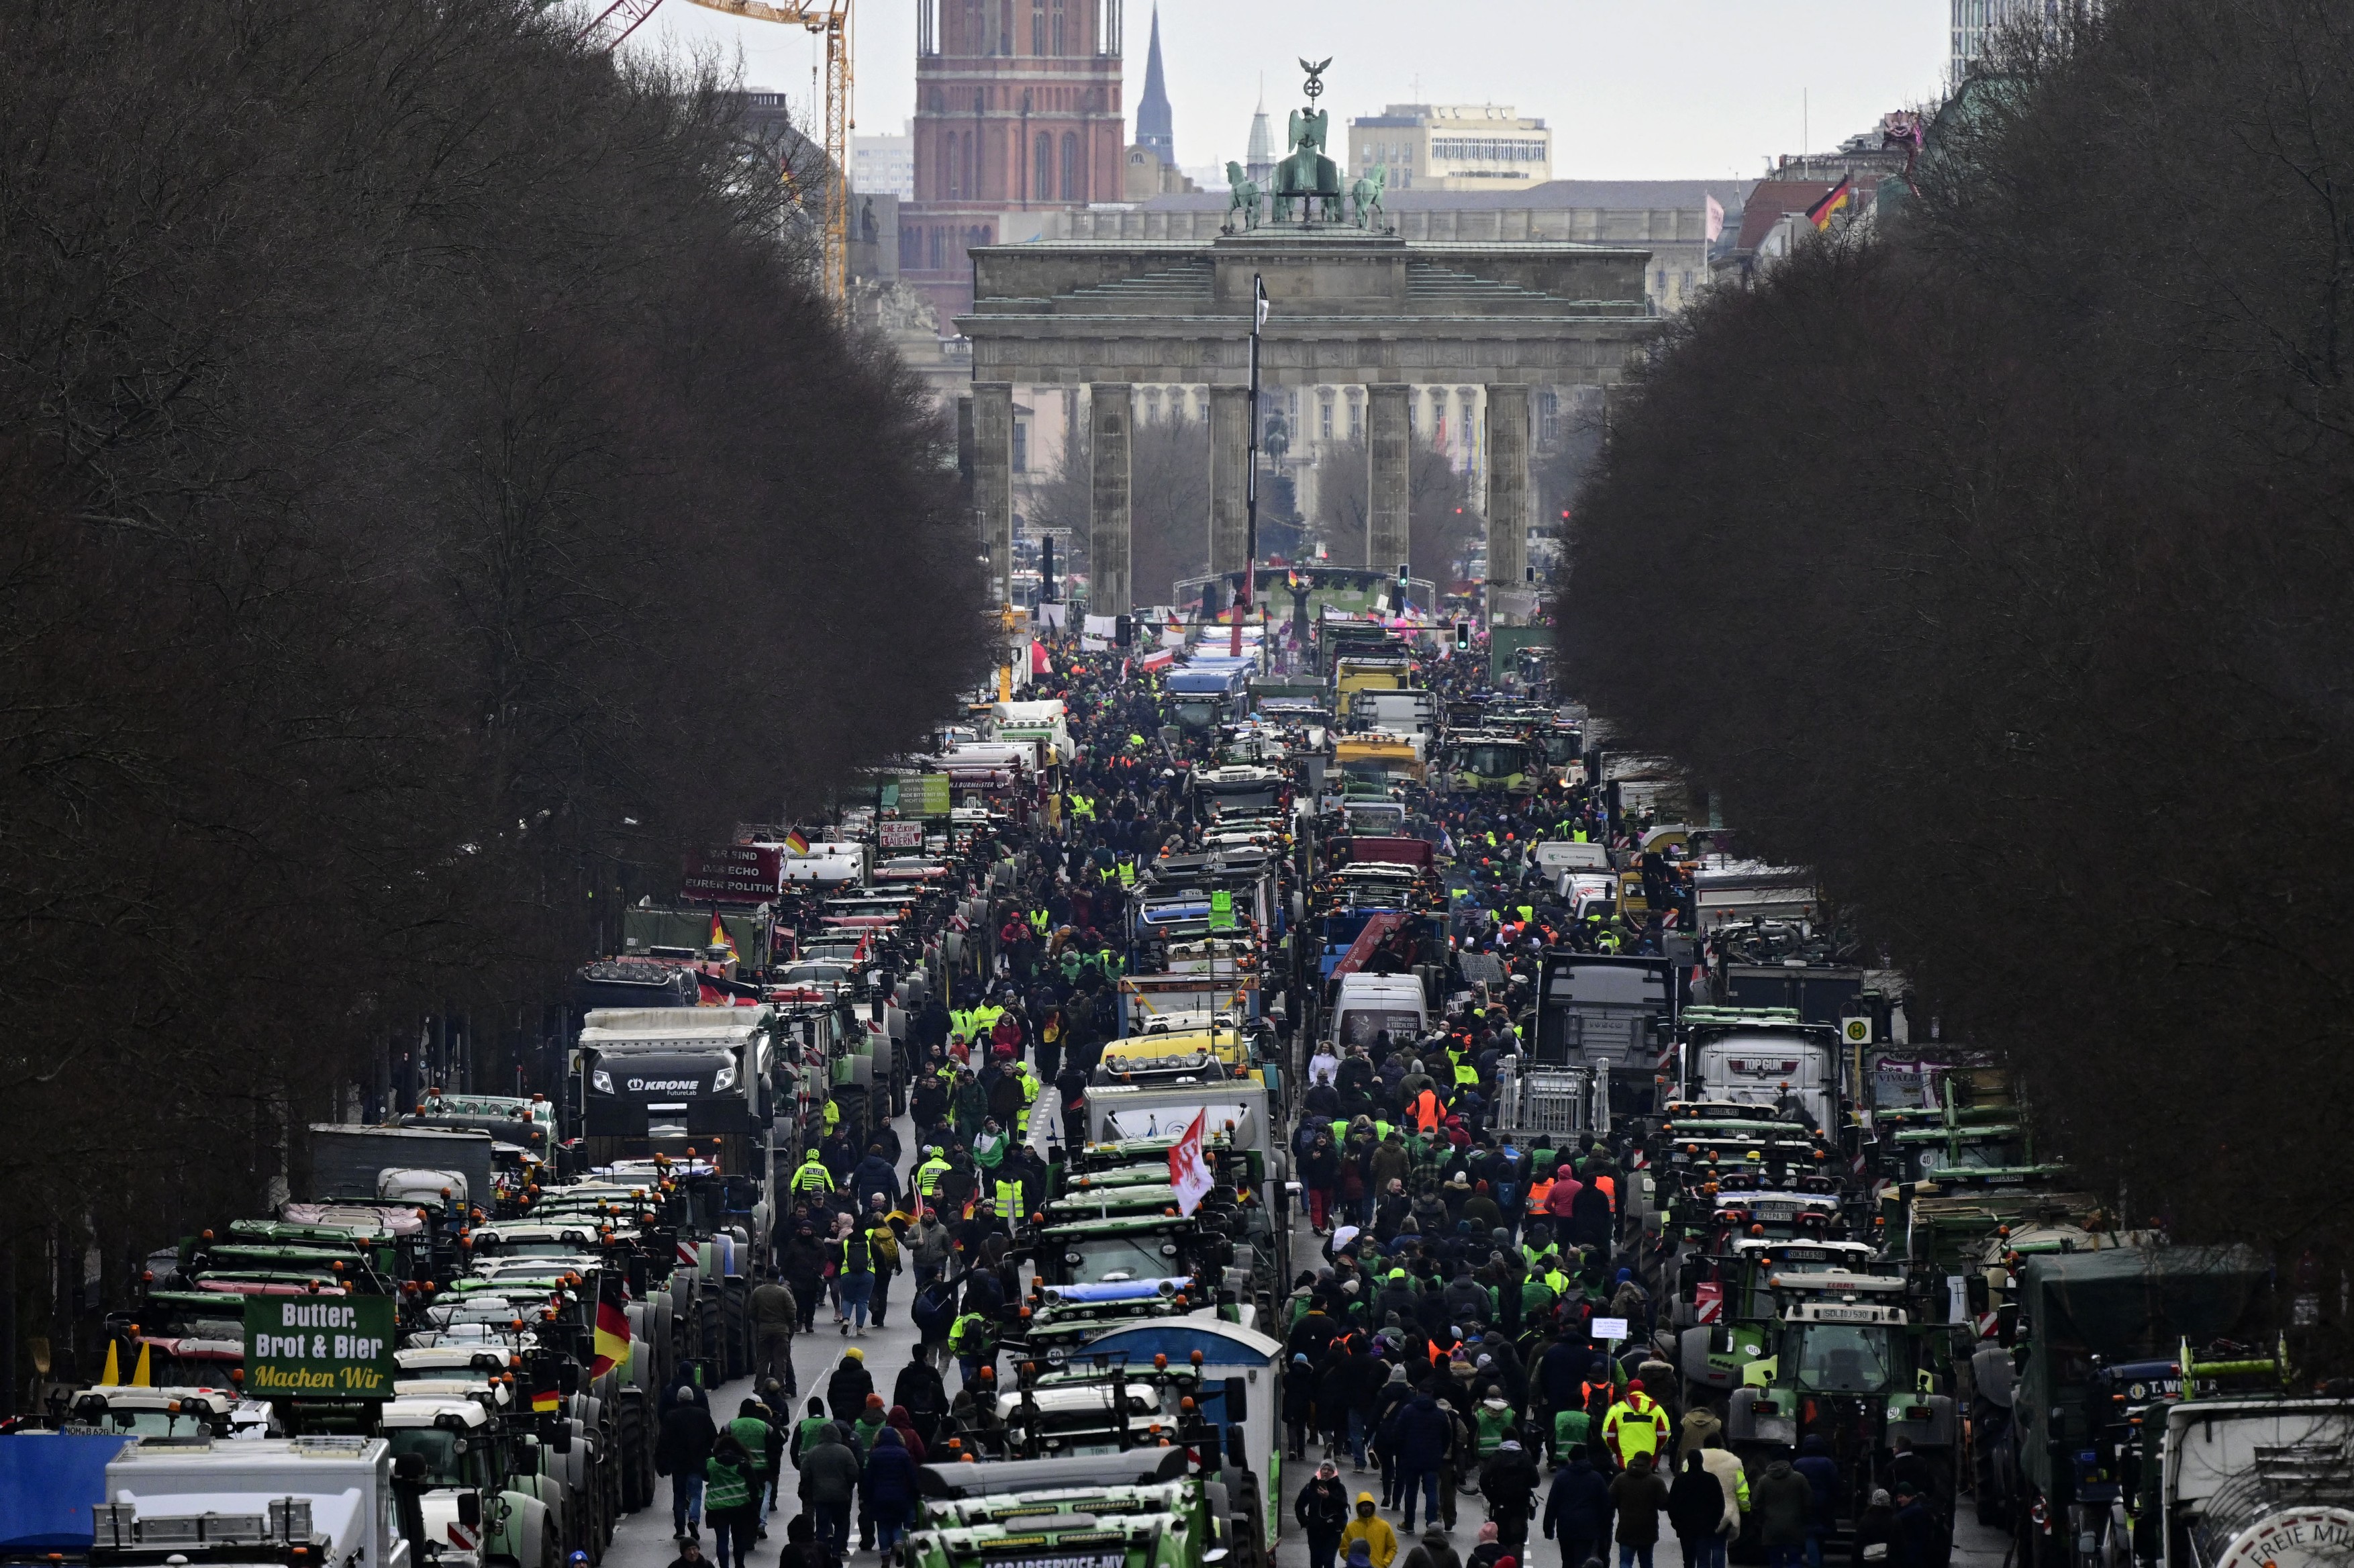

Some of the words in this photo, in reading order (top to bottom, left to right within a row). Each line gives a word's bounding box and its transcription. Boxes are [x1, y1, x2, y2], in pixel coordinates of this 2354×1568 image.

[881, 824, 895, 832] KEINE
[897, 822, 920, 832] ZUKUNFT
[732, 850, 757, 861] SIND
[728, 866, 759, 877] ECHO
[728, 881, 775, 893] POLITIK
[1744, 1059, 1760, 1071] TOP
[1761, 1059, 1783, 1071] GUN
[1879, 1074, 1921, 1082] VIVALDI
[644, 1081, 699, 1090] KRONE
[1922, 1155, 1930, 1165] 40
[282, 1303, 357, 1330] Butter,
[1825, 1310, 1841, 1318] SDL
[1844, 1310, 1852, 1318] DJ
[1853, 1311, 1867, 1319] 530
[256, 1334, 305, 1359] Brot
[312, 1334, 327, 1359] &
[334, 1335, 383, 1359] Bier
[1748, 1345, 1759, 1355] 60
[1050, 1351, 1061, 1363] 50
[254, 1365, 334, 1388] Machen
[340, 1367, 384, 1389] Wir
[2149, 1381, 2161, 1393] T.
[1890, 1408, 1898, 1418] 50
[64, 1427, 81, 1436] NOM
[2251, 1526, 2306, 1567] FREIE
[2314, 1525, 2354, 1549] MIL
